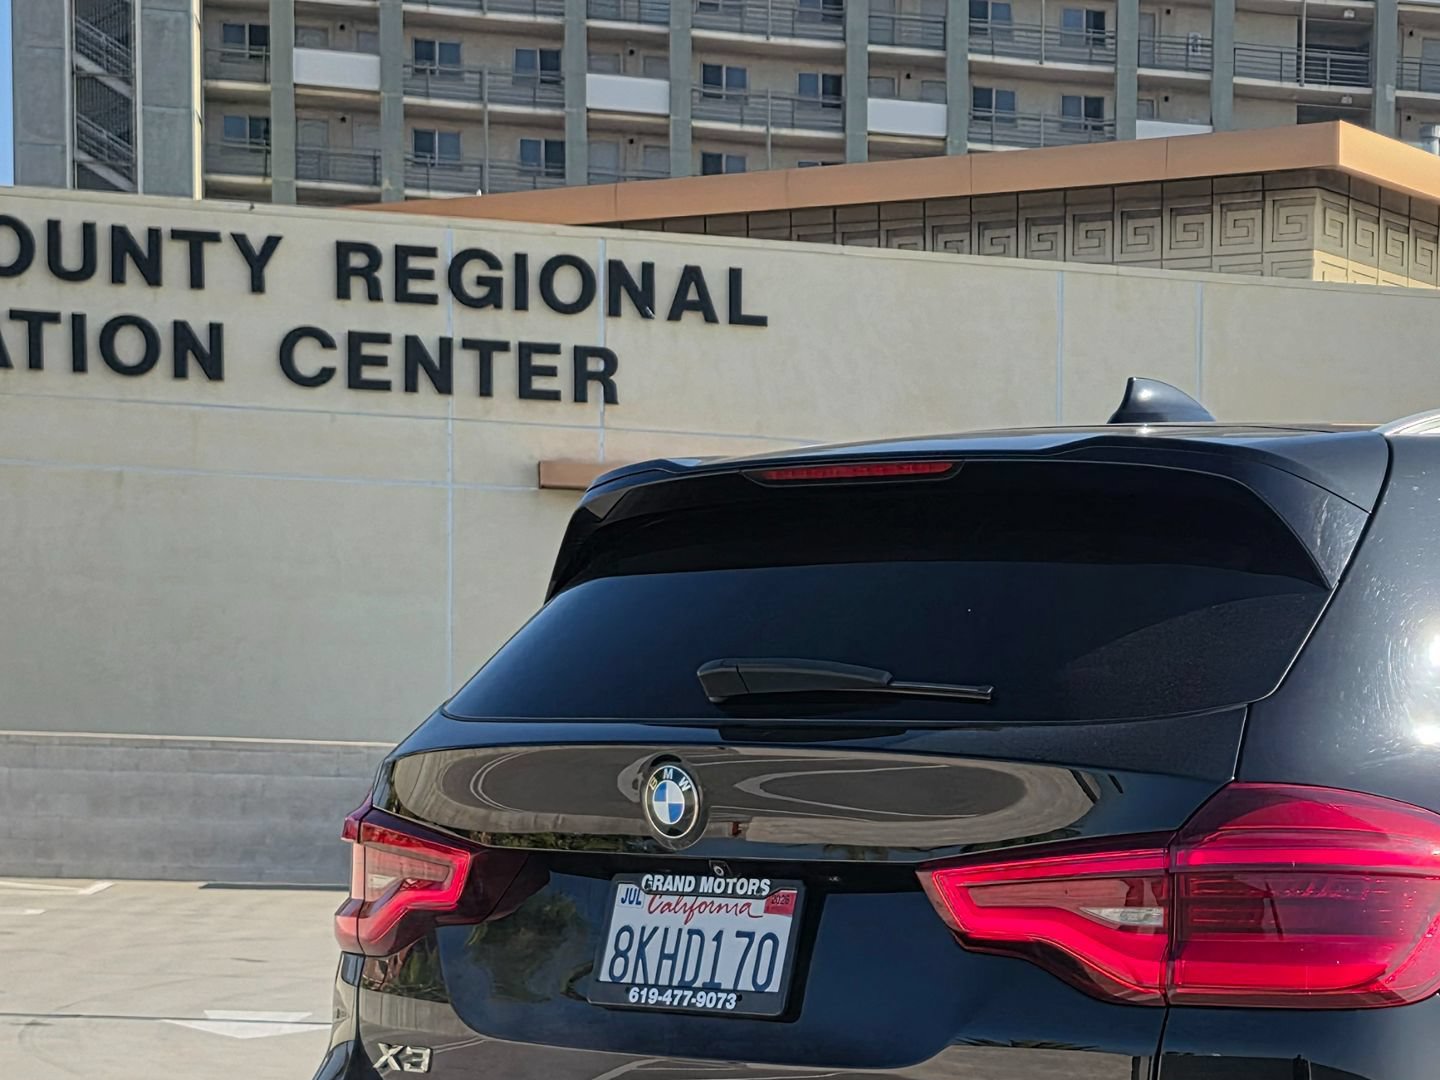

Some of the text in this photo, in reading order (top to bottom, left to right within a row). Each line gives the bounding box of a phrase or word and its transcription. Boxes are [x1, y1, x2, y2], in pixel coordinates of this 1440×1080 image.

[335, 239, 769, 328] REGIONAL
[0, 308, 620, 406] TION CENTER
[649, 768, 692, 792] BMW
[620, 887, 642, 906] JUL
[641, 874, 771, 896] GRAND MOTORS
[647, 894, 763, 925] California
[608, 924, 780, 993] 8KHD170
[628, 986, 738, 1010] 619-477-9073
[373, 1042, 432, 1074] X3
